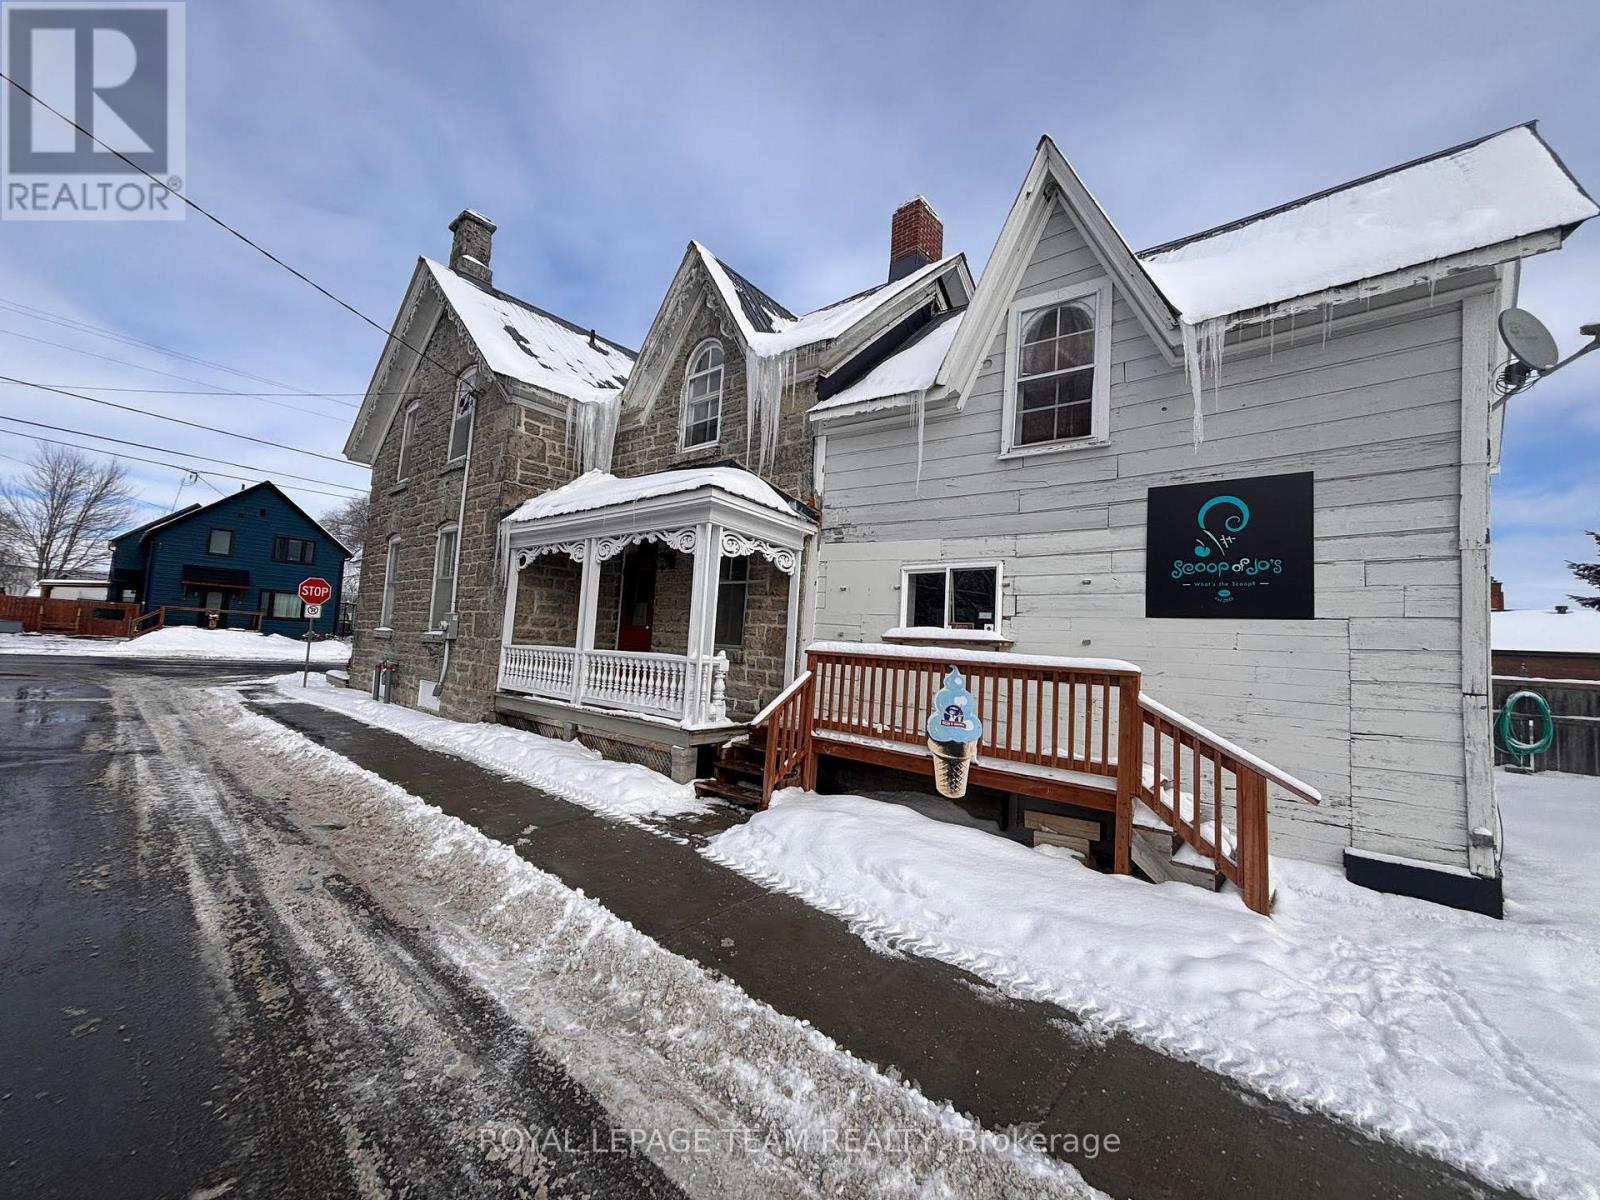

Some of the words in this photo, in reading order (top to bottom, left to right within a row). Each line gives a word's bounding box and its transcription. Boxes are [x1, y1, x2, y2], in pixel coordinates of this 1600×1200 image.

[1171, 559, 1230, 579] Scoop
[1231, 558, 1250, 572] of
[301, 585, 329, 597] STOP
